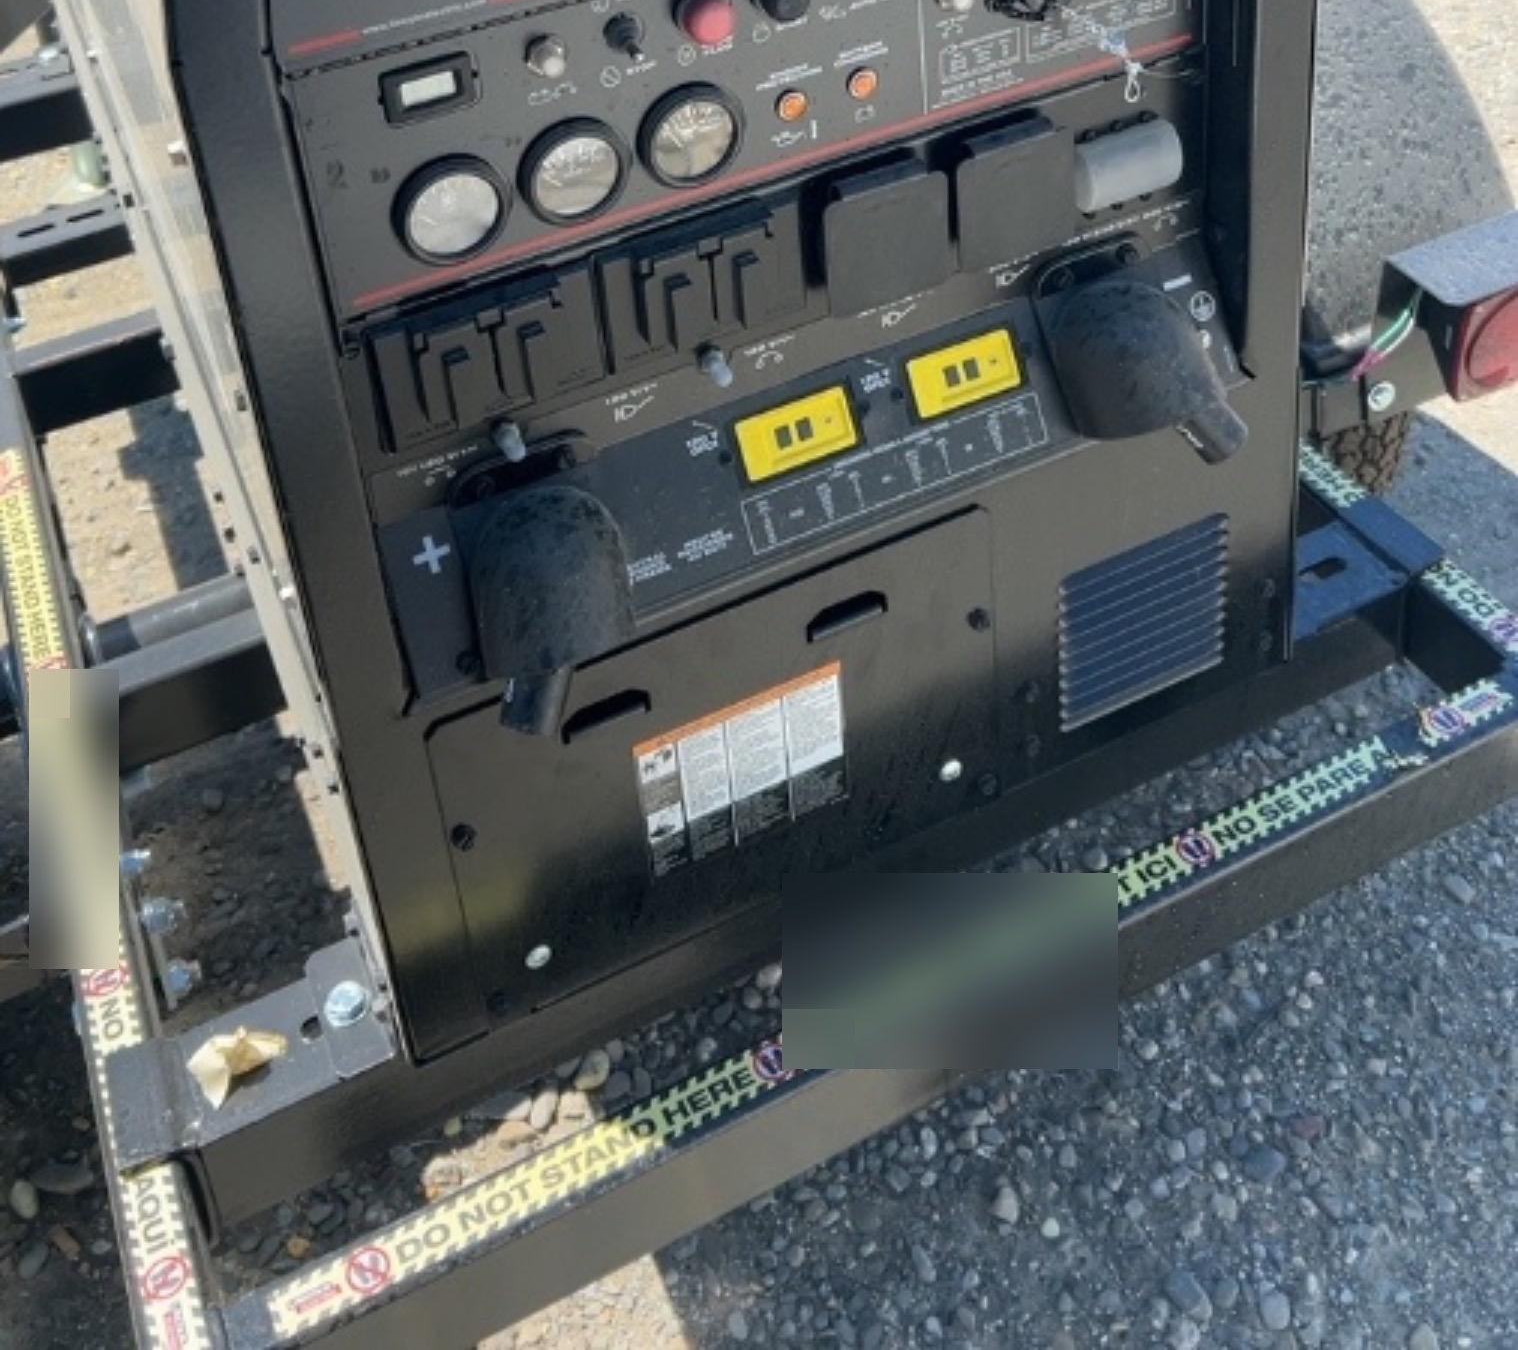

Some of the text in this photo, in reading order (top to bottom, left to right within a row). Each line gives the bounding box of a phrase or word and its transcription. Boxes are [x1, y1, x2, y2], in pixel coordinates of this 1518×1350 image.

[1212, 816, 1256, 845] NO
[1260, 786, 1297, 819] SE
[1298, 757, 1366, 803] PARE
[1136, 854, 1178, 883] ICI
[99, 997, 124, 1041] NO
[395, 1066, 755, 1264] DO NOT STAND HERE
